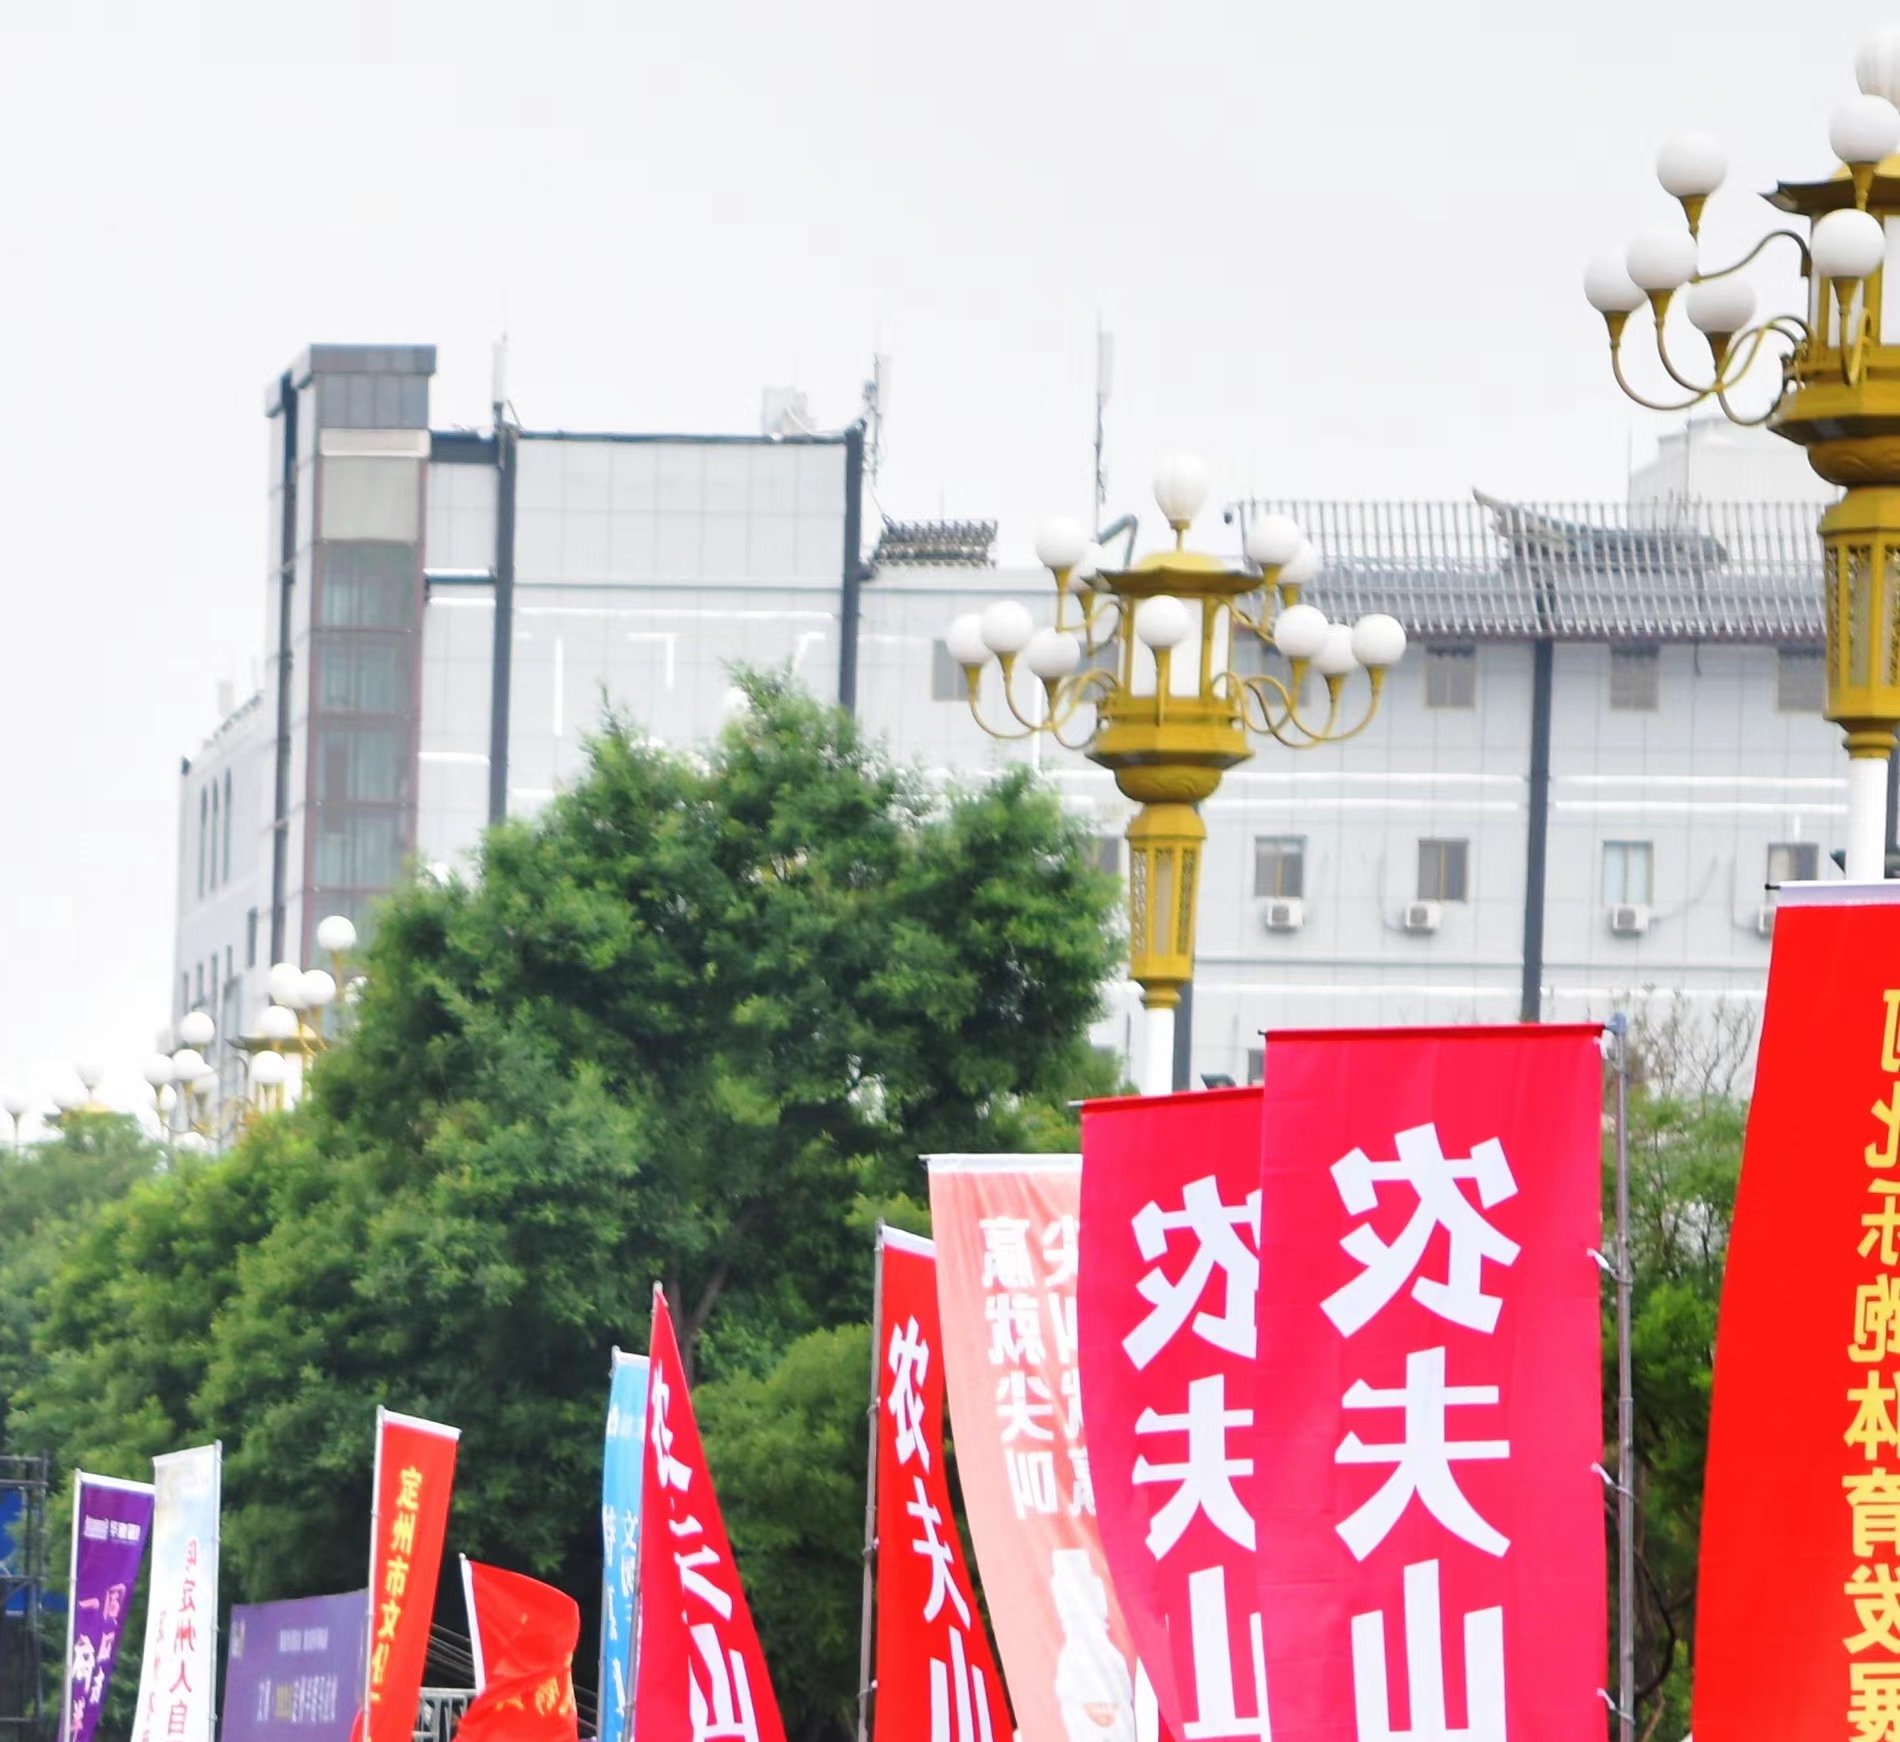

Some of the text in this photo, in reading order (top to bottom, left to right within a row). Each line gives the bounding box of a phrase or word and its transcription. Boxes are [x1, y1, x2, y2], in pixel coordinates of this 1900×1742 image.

[370, 1465, 423, 1703] 定州市文化
